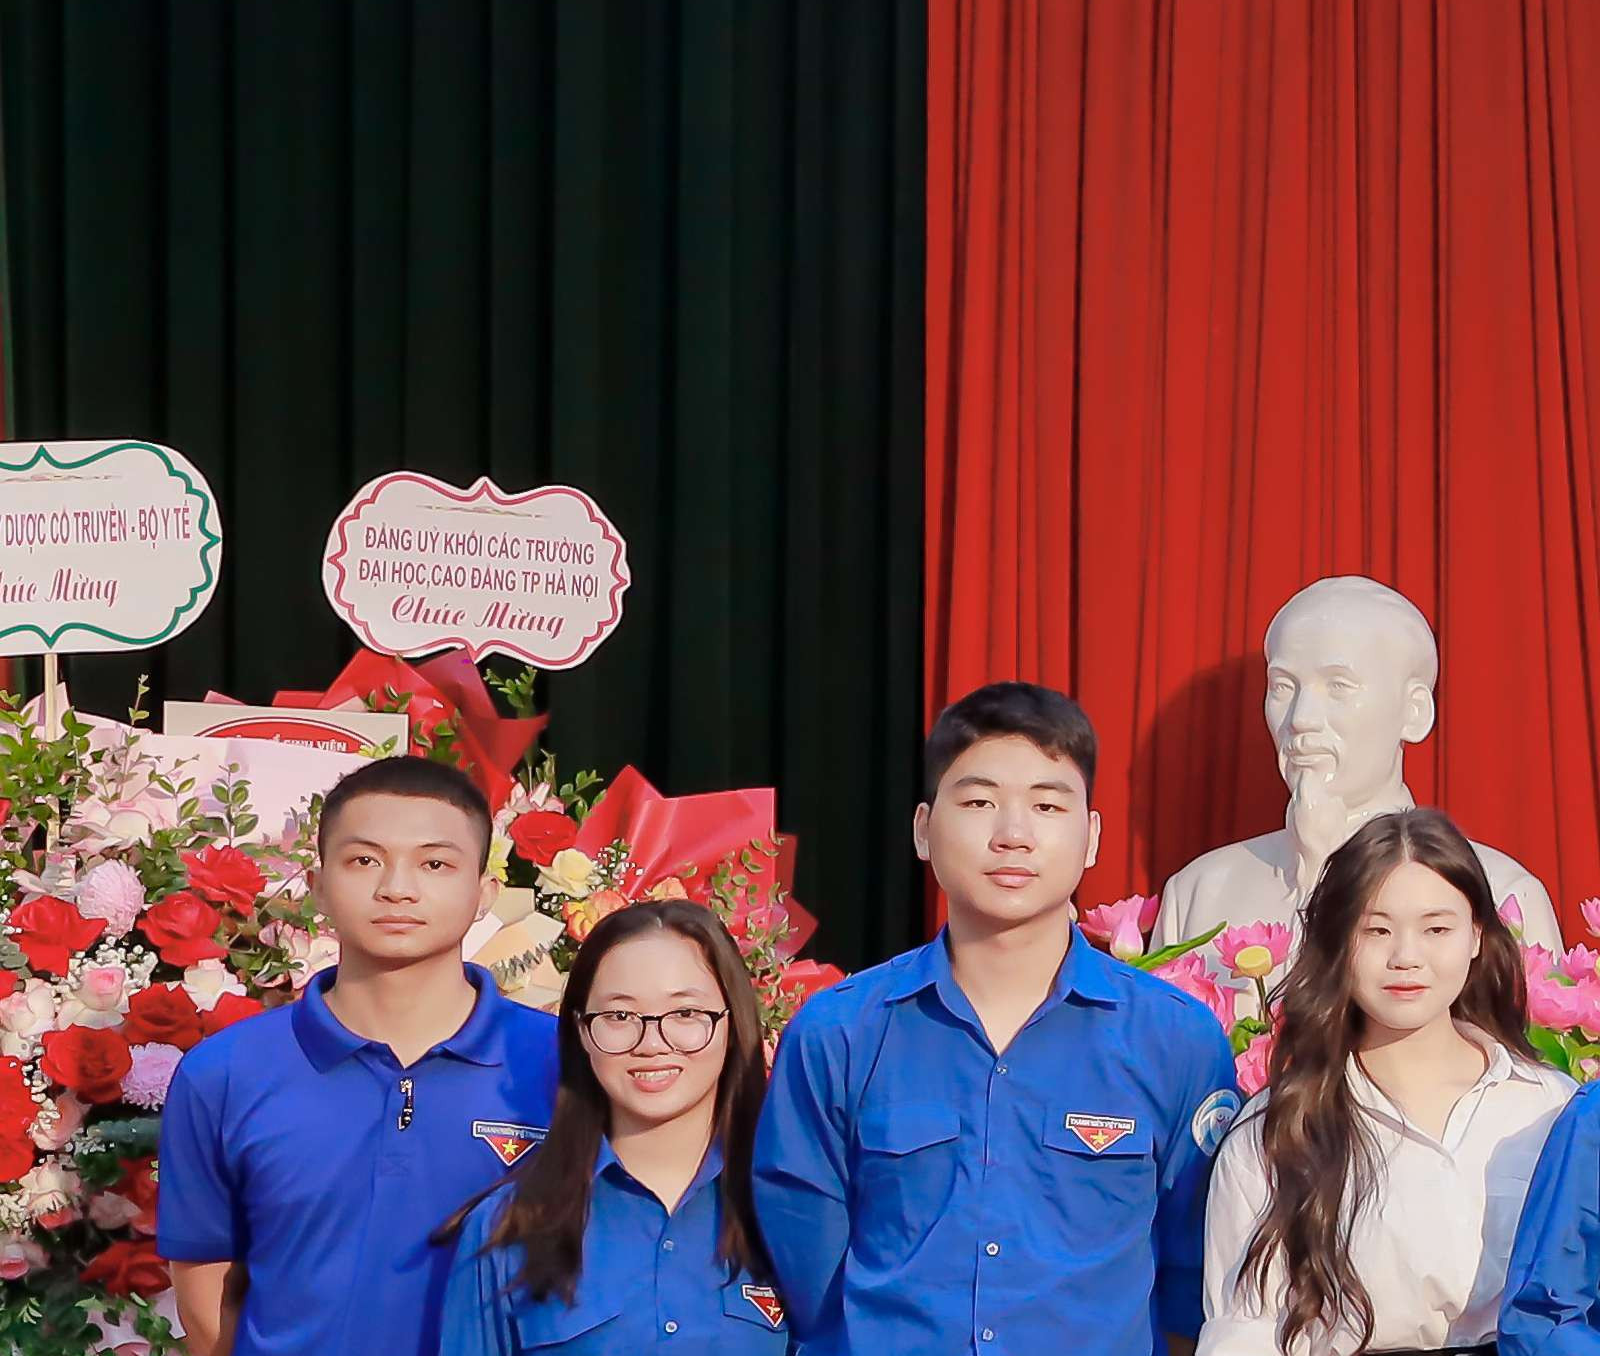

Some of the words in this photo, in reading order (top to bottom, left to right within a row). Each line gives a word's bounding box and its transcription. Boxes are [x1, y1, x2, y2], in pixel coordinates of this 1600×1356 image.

[5, 512, 46, 555] DƯỢC
[138, 505, 158, 549] BỘ
[161, 508, 170, 540] Y
[365, 521, 413, 552] ĐẢNG
[487, 531, 521, 560] CÁC
[0, 570, 38, 604] húc
[43, 567, 119, 608] Mừng
[359, 558, 387, 587] ĐẠI
[521, 570, 542, 594] TP
[544, 568, 567, 596] HÀ
[571, 572, 600, 603] NỘI
[391, 594, 467, 627] Chúc
[473, 601, 566, 640] Mừng
